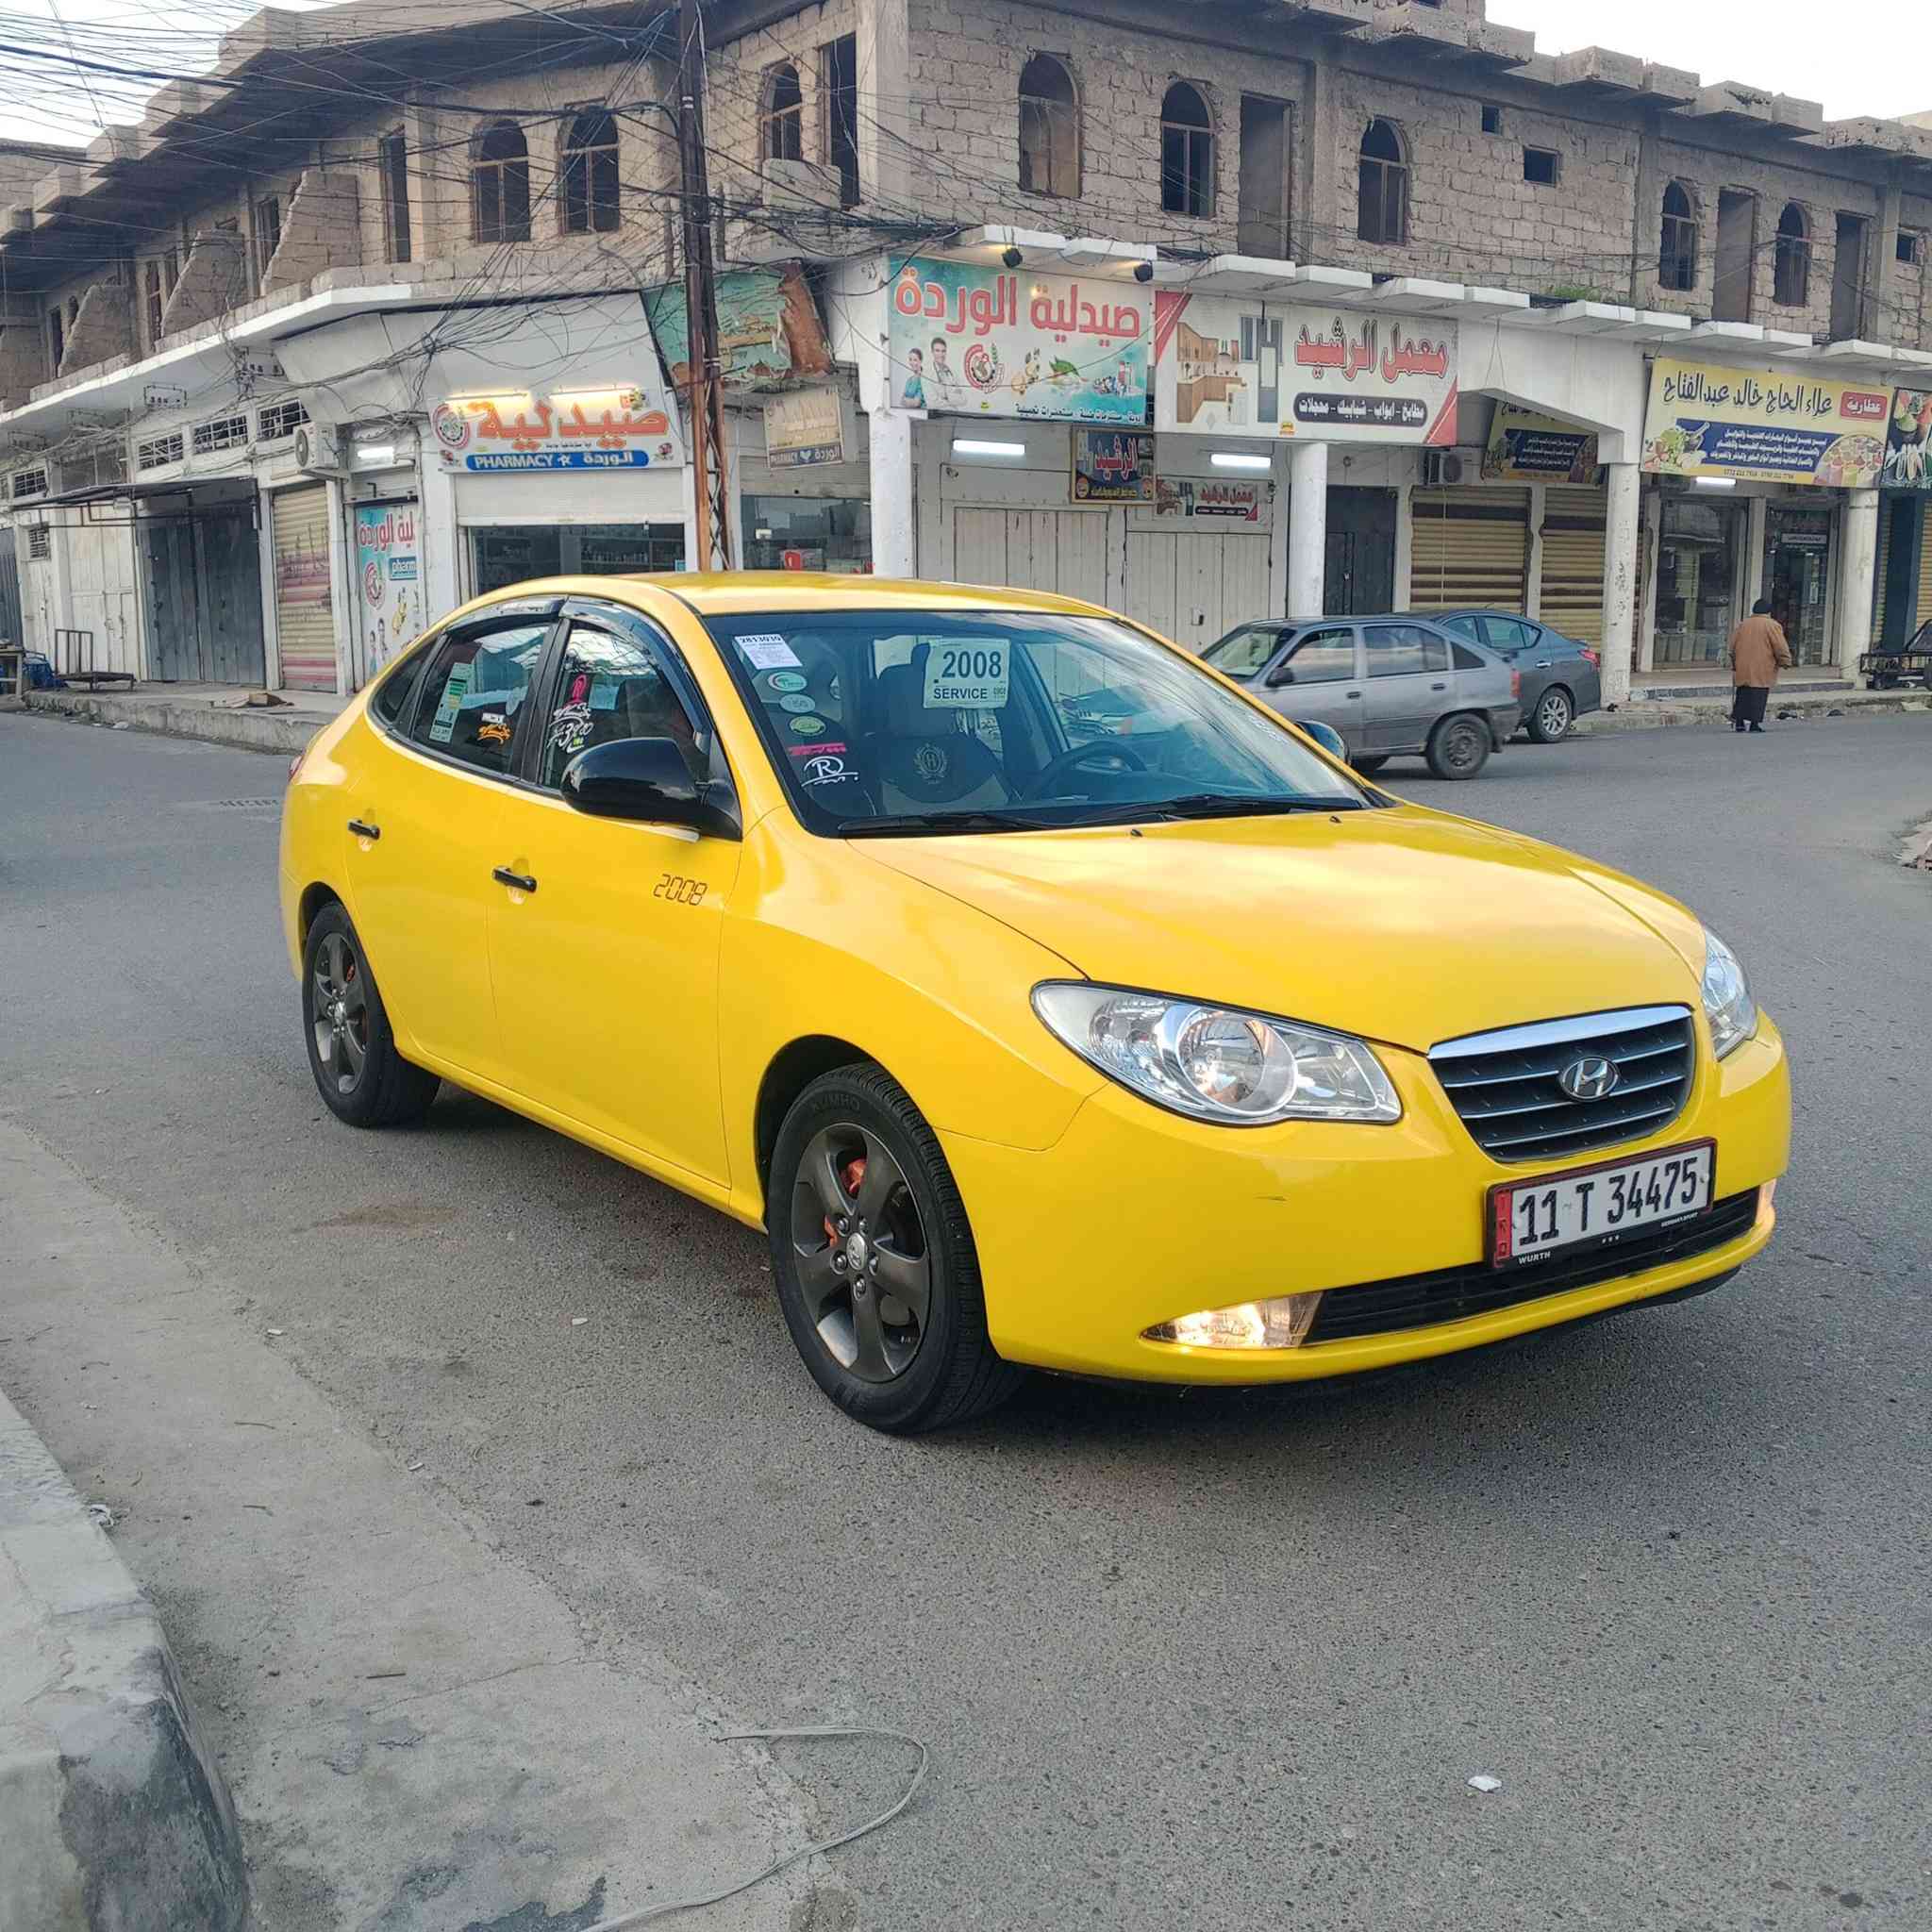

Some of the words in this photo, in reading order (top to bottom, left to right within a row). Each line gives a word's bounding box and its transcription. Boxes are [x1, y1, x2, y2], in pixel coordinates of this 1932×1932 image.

[896, 266, 1018, 336] الوردة
[1030, 285, 1141, 347] صيدلية
[1295, 317, 1377, 381] الرشيد
[1381, 323, 1449, 383] معمل
[1733, 377, 1763, 408] خالد
[1766, 383, 1805, 415] الحاج
[1805, 387, 1833, 417] علاء
[468, 400, 670, 452] صيدلية
[475, 454, 554, 469] PHARMACY
[583, 451, 634, 466] الوردة
[1095, 435, 1139, 480] الرشيد
[941, 651, 1002, 678] 2008
[933, 688, 988, 700] SERVICE
[654, 874, 708, 907] 2008
[1519, 1190, 1559, 1246] 11
[1575, 1181, 1594, 1232] T
[1607, 1157, 1698, 1224] 34475
[1518, 1251, 1551, 1265] WURTH
